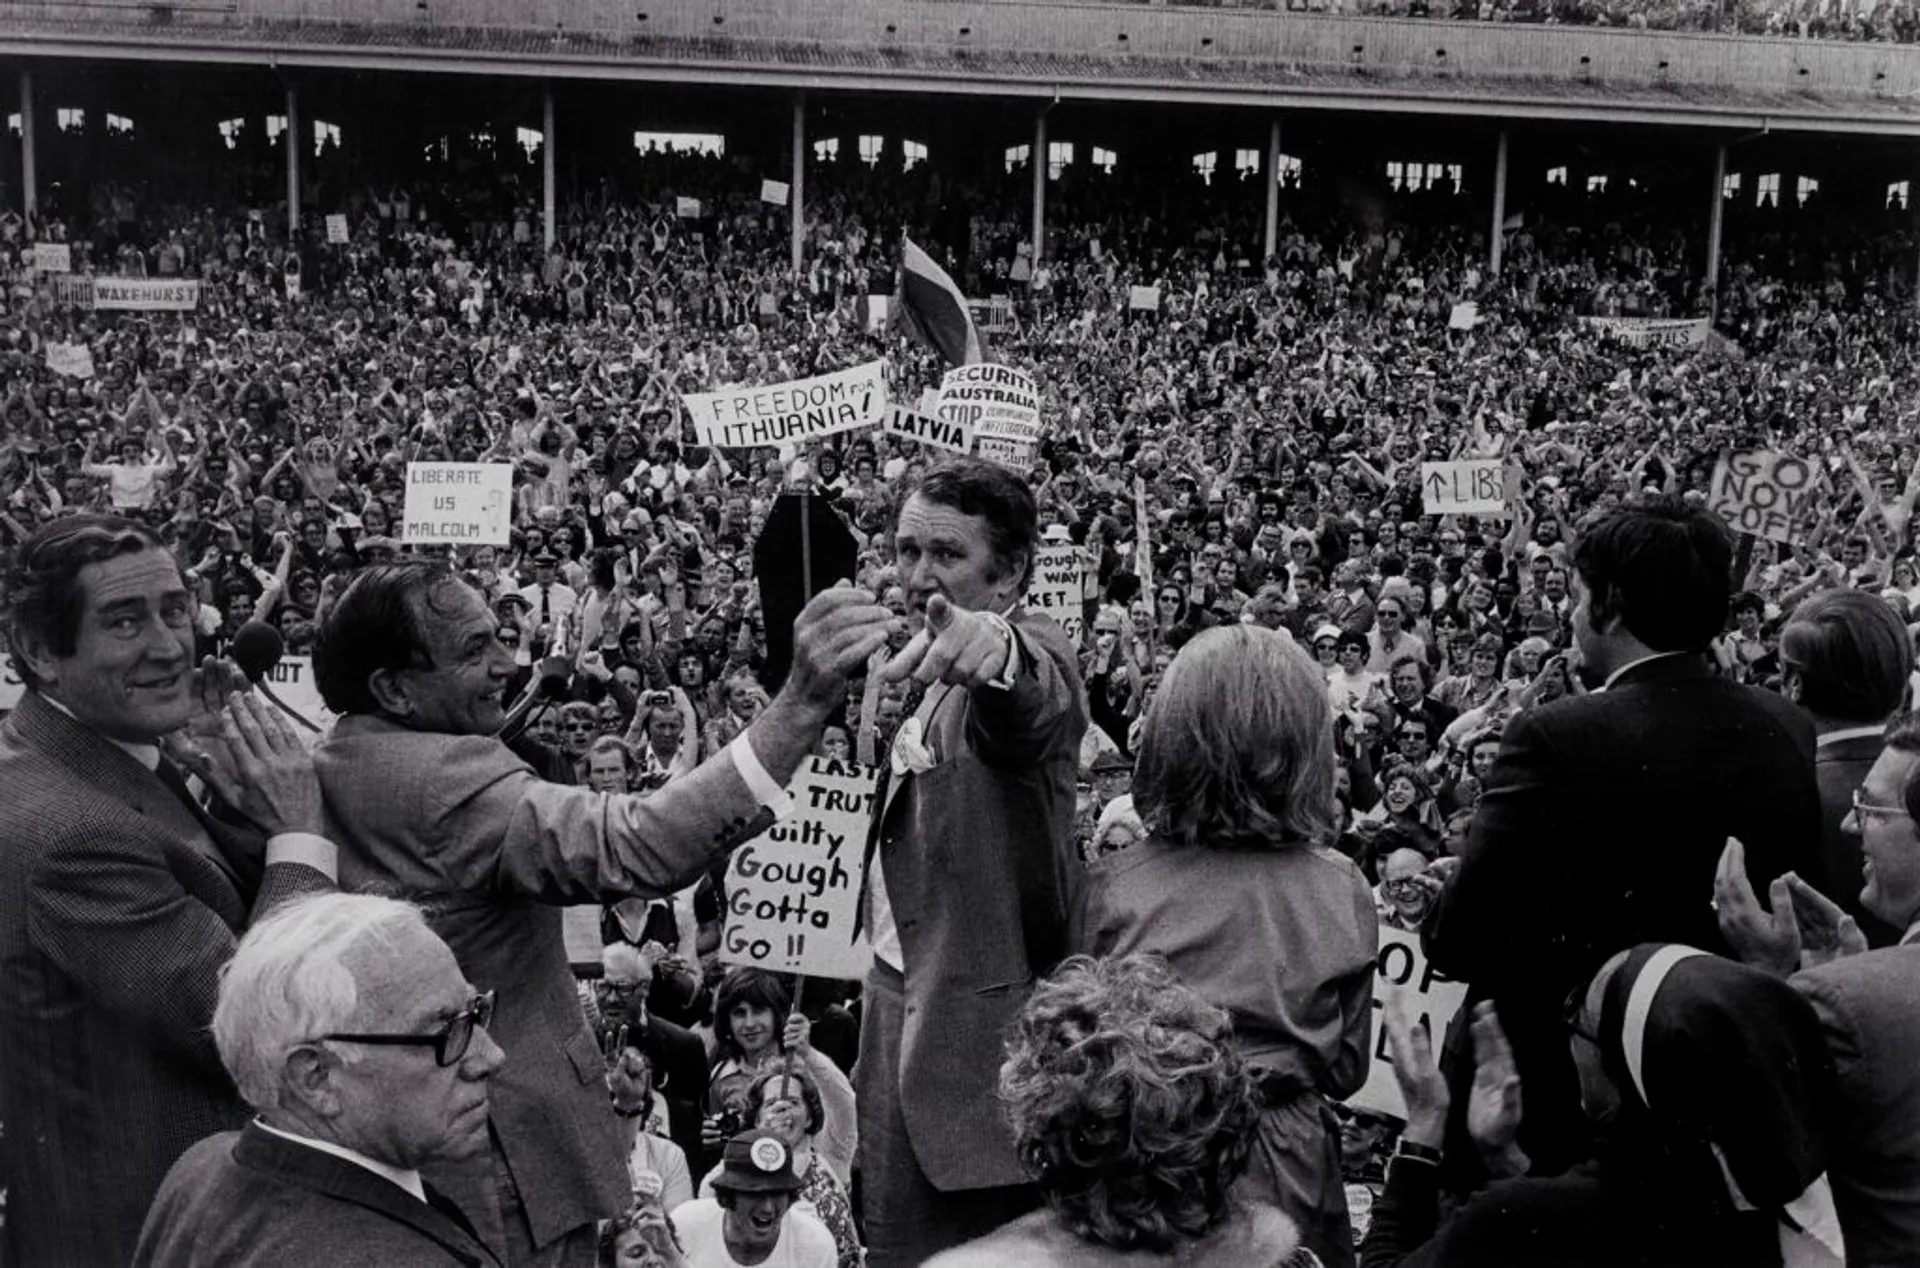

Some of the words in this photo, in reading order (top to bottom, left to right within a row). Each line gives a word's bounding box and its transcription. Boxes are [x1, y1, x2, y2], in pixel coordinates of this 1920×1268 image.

[97, 287, 197, 302] WAKEHURST
[947, 366, 1034, 393] SECURITY
[711, 381, 845, 421] FREEDOM
[850, 379, 875, 396] FOR
[942, 387, 1037, 410] AUSTRALIA
[892, 410, 964, 448] LATVIA
[411, 469, 482, 484] LIBERATE
[1453, 466, 1504, 503] LIBS
[1728, 450, 1809, 489] GO
[434, 496, 456, 511] US
[1721, 472, 1807, 516] NOW
[408, 522, 480, 538] MALCOLM
[1714, 499, 1804, 541] GOFF
[1044, 571, 1079, 585] WAY
[1020, 591, 1067, 608] KET
[810, 758, 880, 781] LAST
[808, 785, 877, 815] TRUT
[769, 819, 845, 860] uilty
[736, 847, 849, 897] Gough
[730, 888, 830, 930] Gotta
[726, 925, 771, 960] Go
[786, 933, 805, 966] !!
